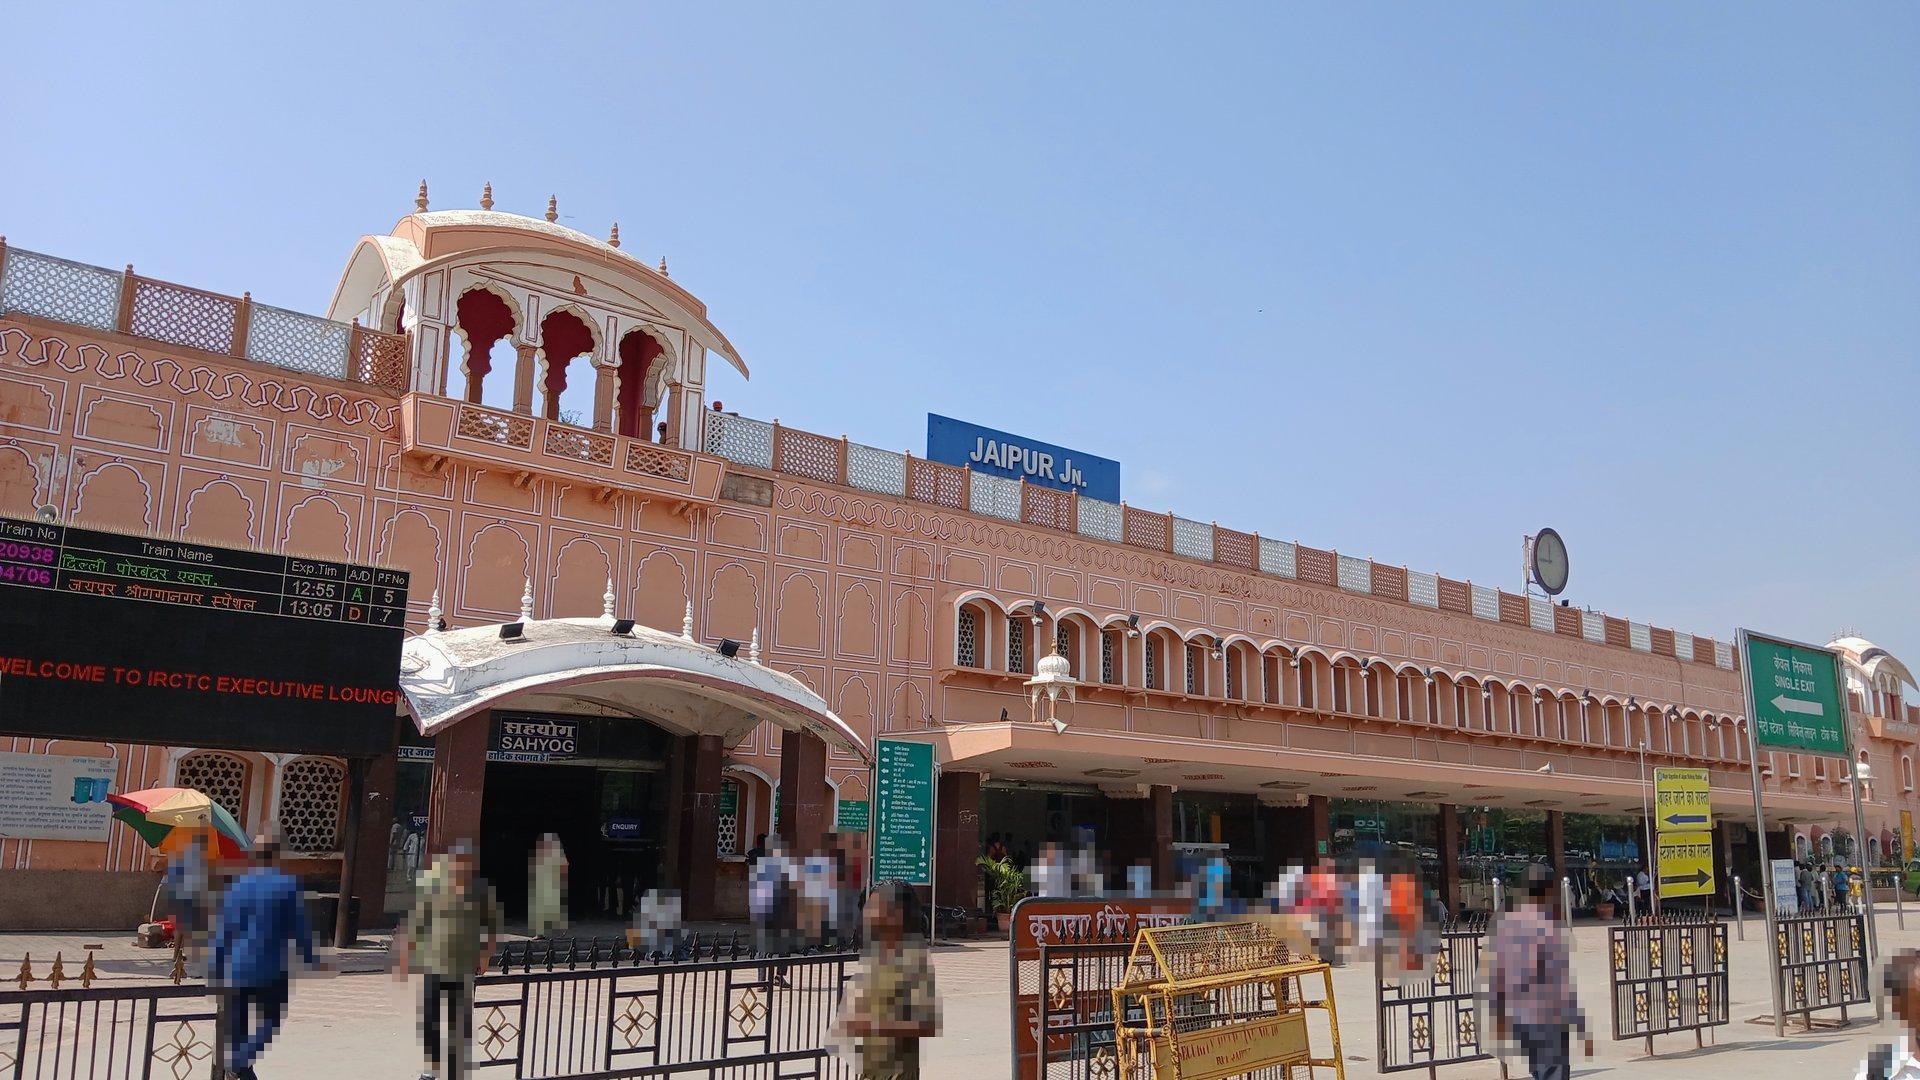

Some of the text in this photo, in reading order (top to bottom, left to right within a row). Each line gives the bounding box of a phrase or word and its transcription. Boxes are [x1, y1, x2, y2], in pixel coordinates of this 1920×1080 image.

[969, 436, 1054, 480] JAIPUR
[0, 521, 57, 541] Train No
[141, 542, 214, 563] Train Name
[62, 553, 107, 574] दिल्ली
[68, 578, 117, 597] जयपुर
[292, 580, 336, 599] 12:55
[351, 587, 363, 602] A
[384, 589, 395, 604] 5
[290, 601, 333, 618] 13:05
[348, 607, 361, 621] D
[0, 656, 105, 683] WELCOME
[113, 667, 142, 685] TO
[148, 671, 211, 692] IRCTC
[217, 676, 324, 700] EXECUTIVE
[1774, 675, 1816, 693] SINGLE EXIT
[504, 720, 576, 738] सहयोग
[501, 736, 575, 753] SAHYOG
[611, 823, 638, 831] ENQUIRY
